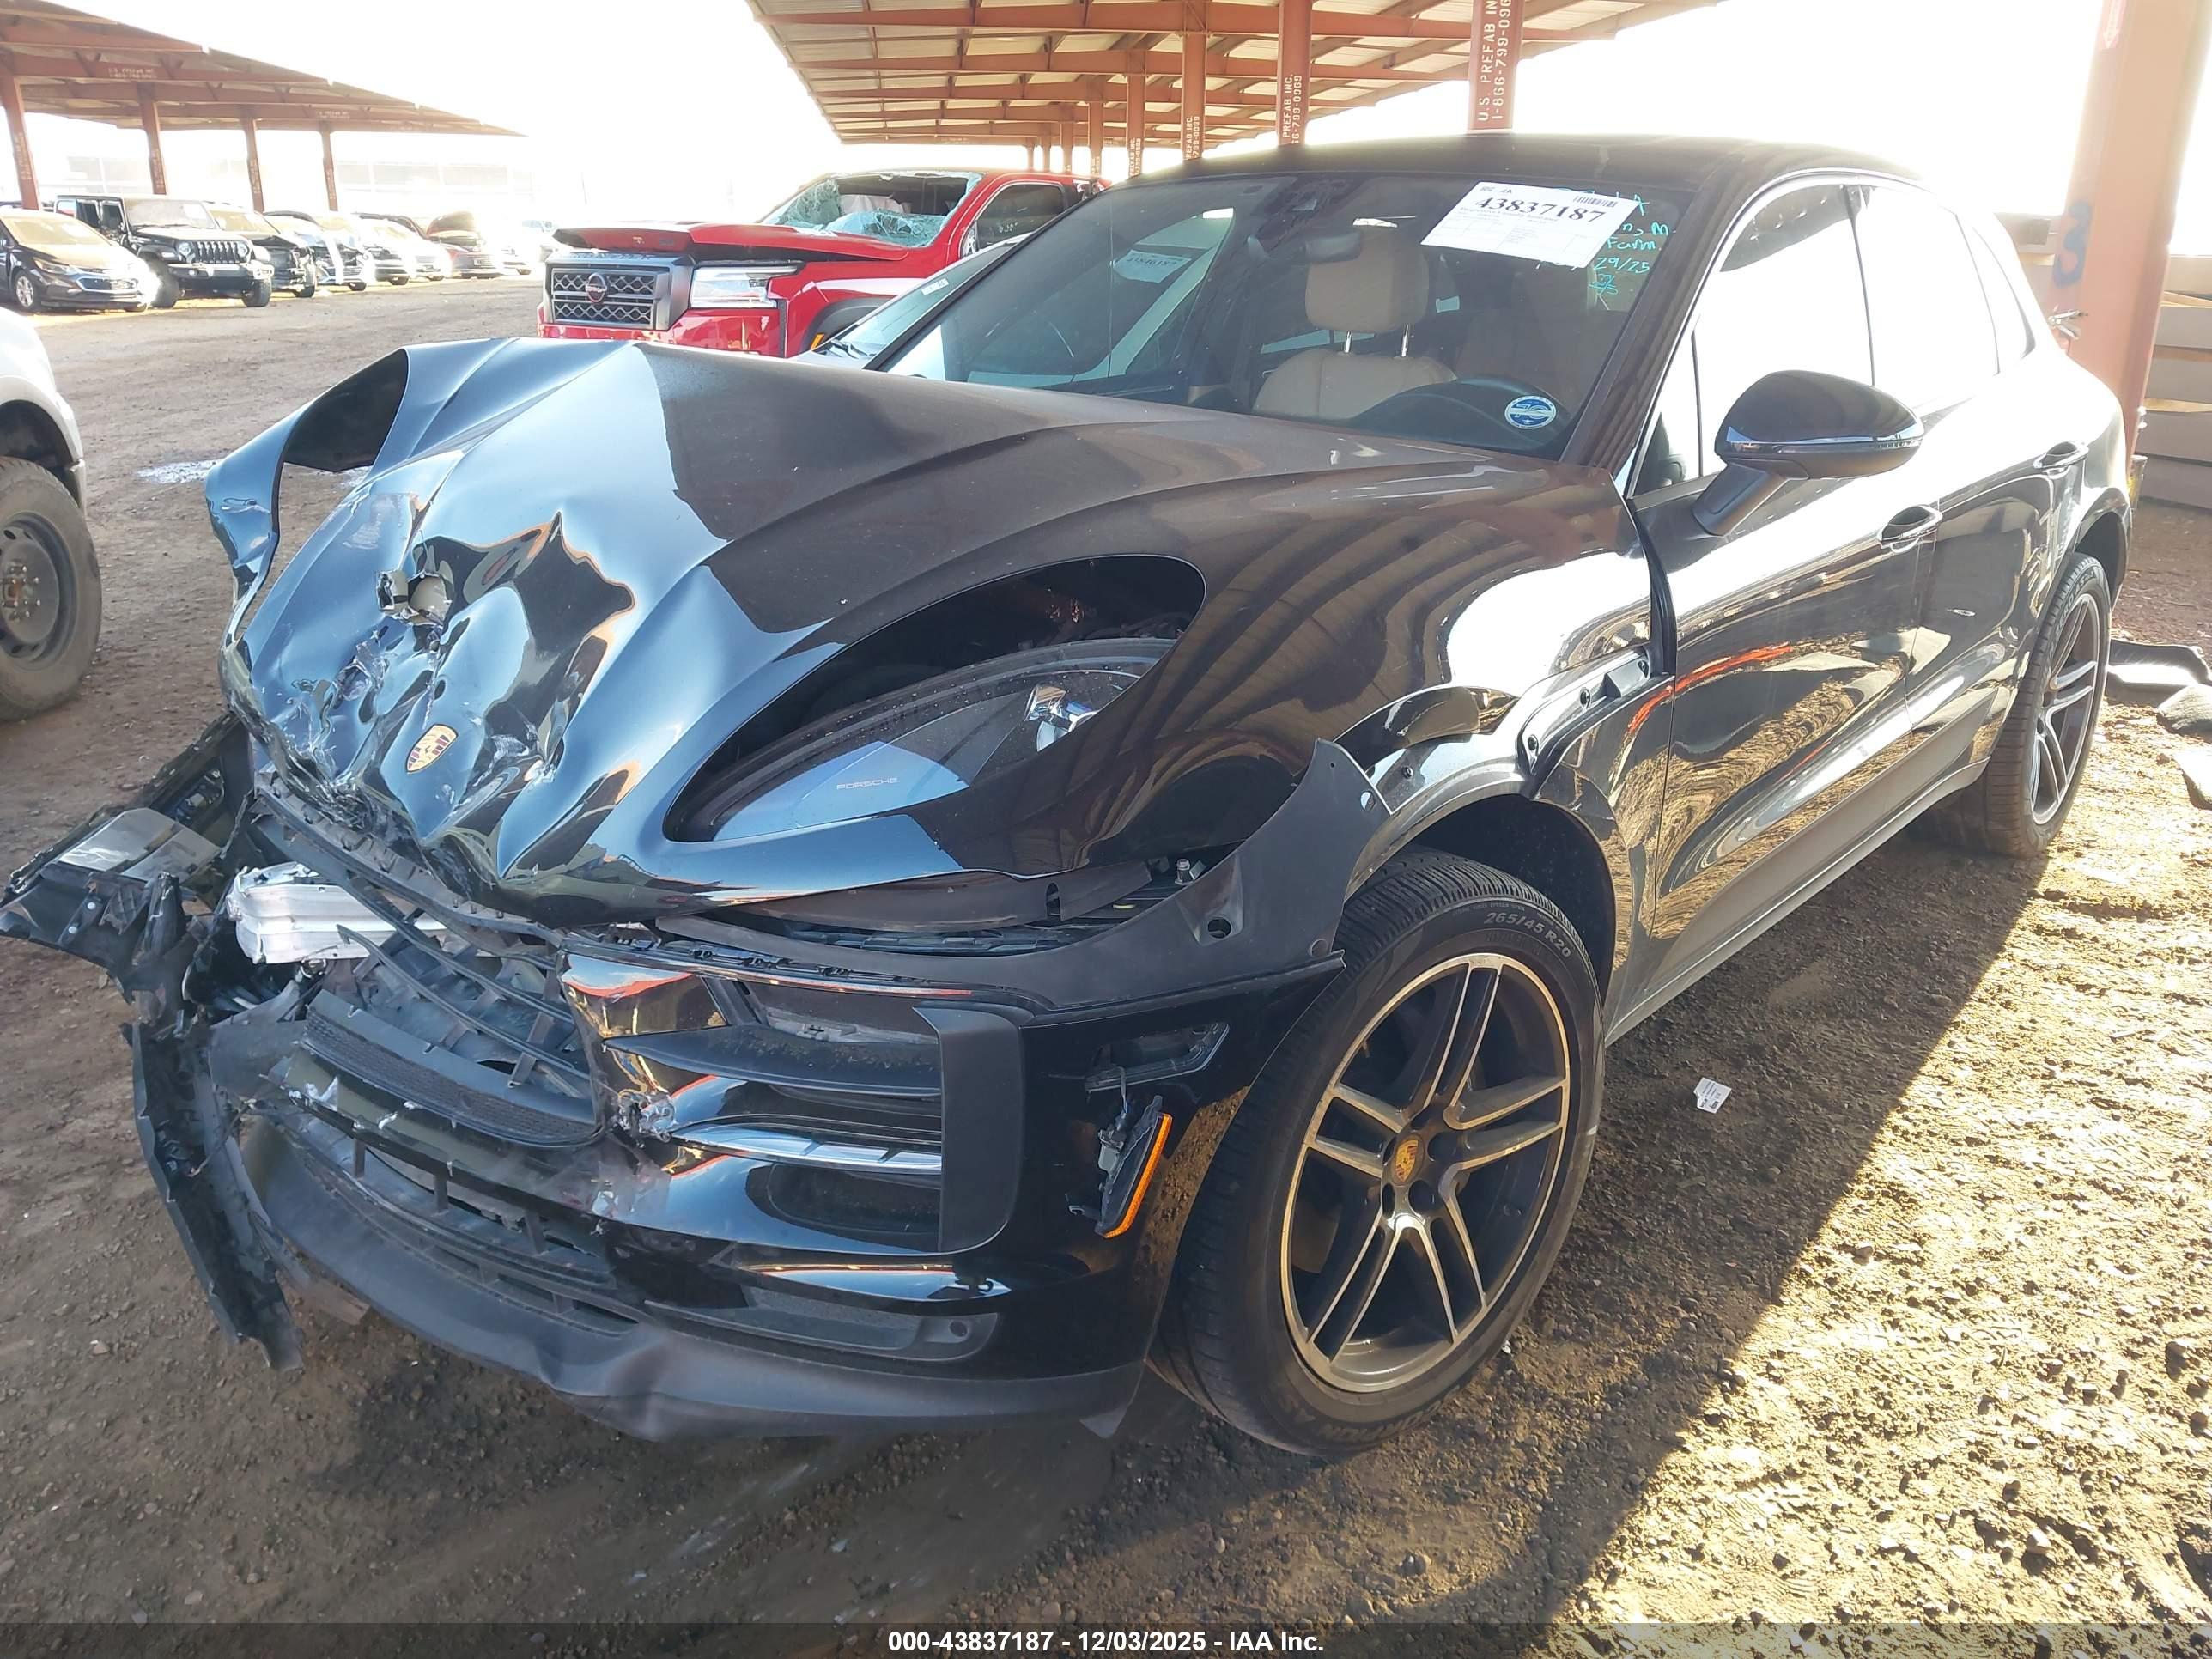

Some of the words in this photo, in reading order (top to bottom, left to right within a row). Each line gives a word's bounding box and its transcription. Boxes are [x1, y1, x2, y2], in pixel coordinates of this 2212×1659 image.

[1480, 23, 1496, 83] PREFAB
[1284, 74, 1294, 94] INC.
[1282, 99, 1292, 138] PREFAB
[1477, 92, 1492, 121] U.S.
[1474, 197, 1607, 222] 43837187
[836, 777, 898, 790] PORSCHE
[1484, 912, 1545, 933] 265/45
[1545, 930, 1572, 958] R20
